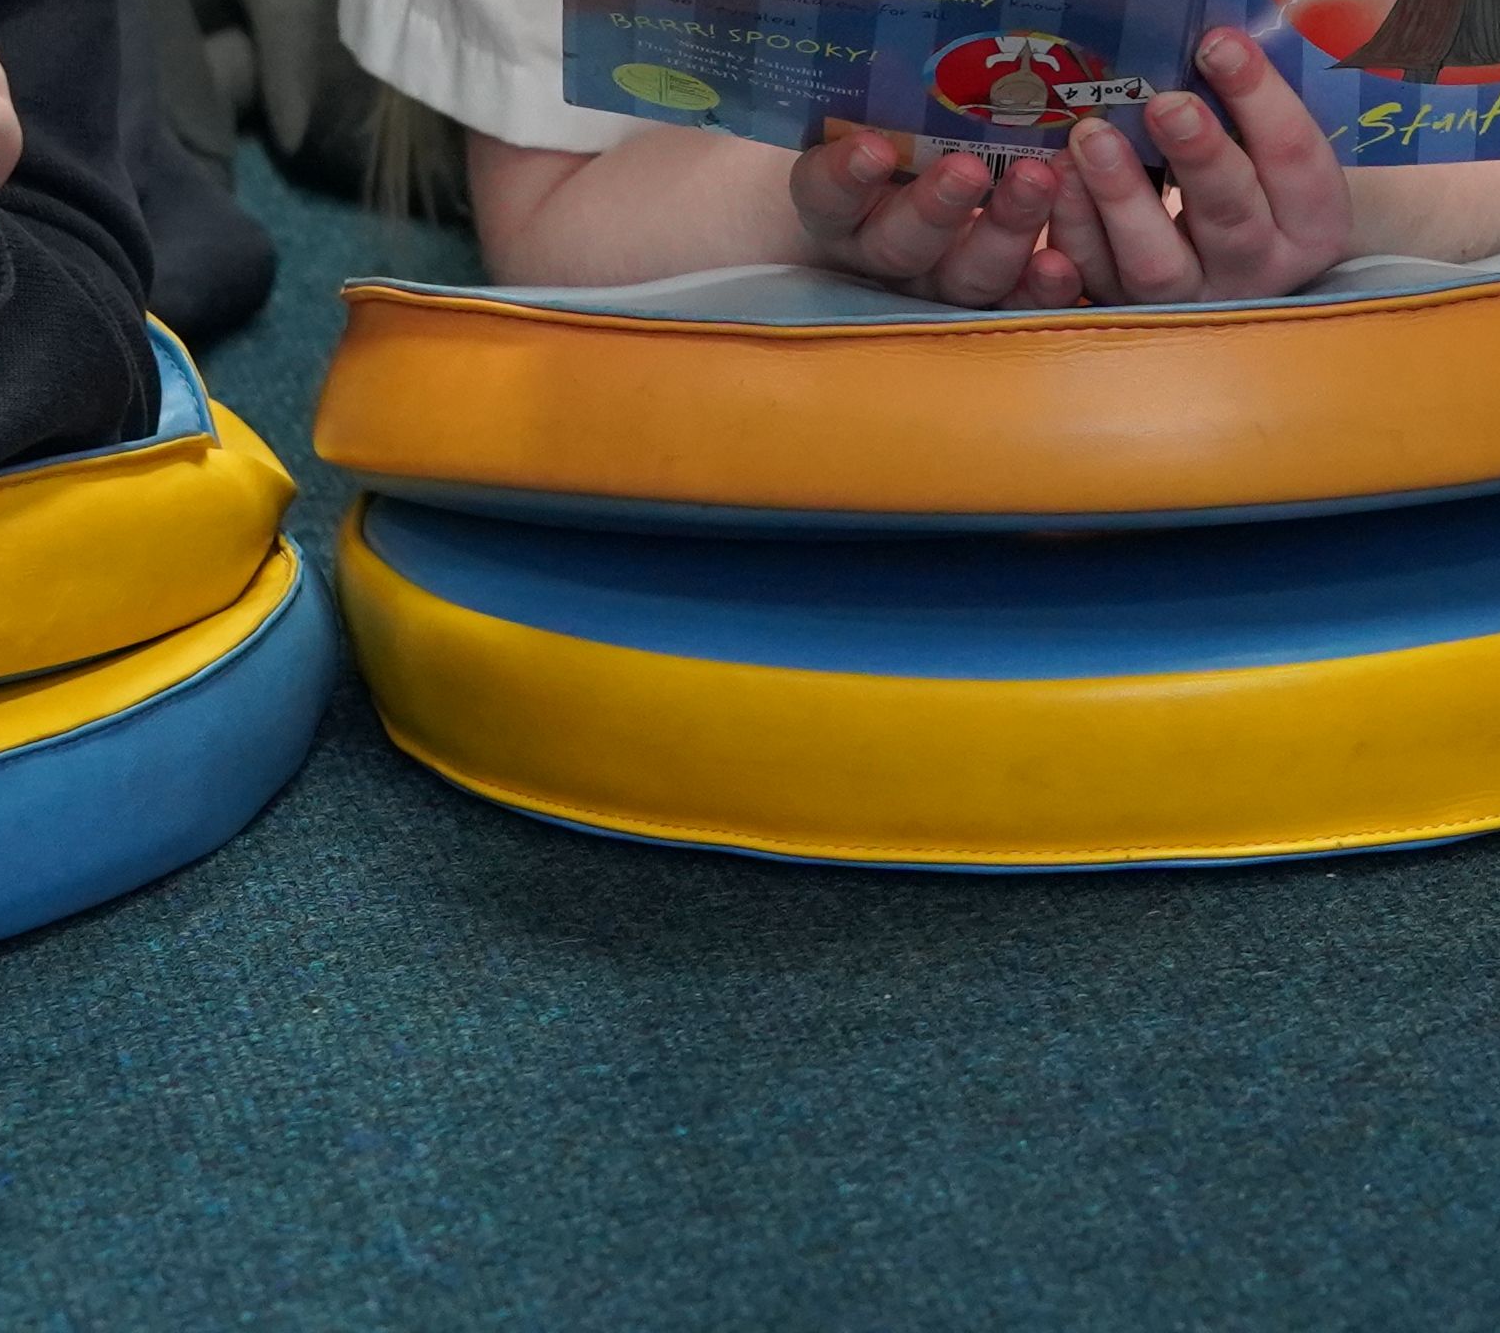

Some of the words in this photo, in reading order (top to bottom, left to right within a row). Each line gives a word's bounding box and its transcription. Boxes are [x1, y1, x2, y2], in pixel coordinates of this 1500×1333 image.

[924, 8, 950, 20] all
[608, 11, 716, 39] BRRR!
[728, 28, 880, 66] SPOOKY!
[677, 48, 721, 65] book
[748, 77, 833, 104] STRONG
[1064, 86, 1079, 100] 4
[1089, 77, 1150, 103] Book
[931, 137, 961, 148] ISBN
